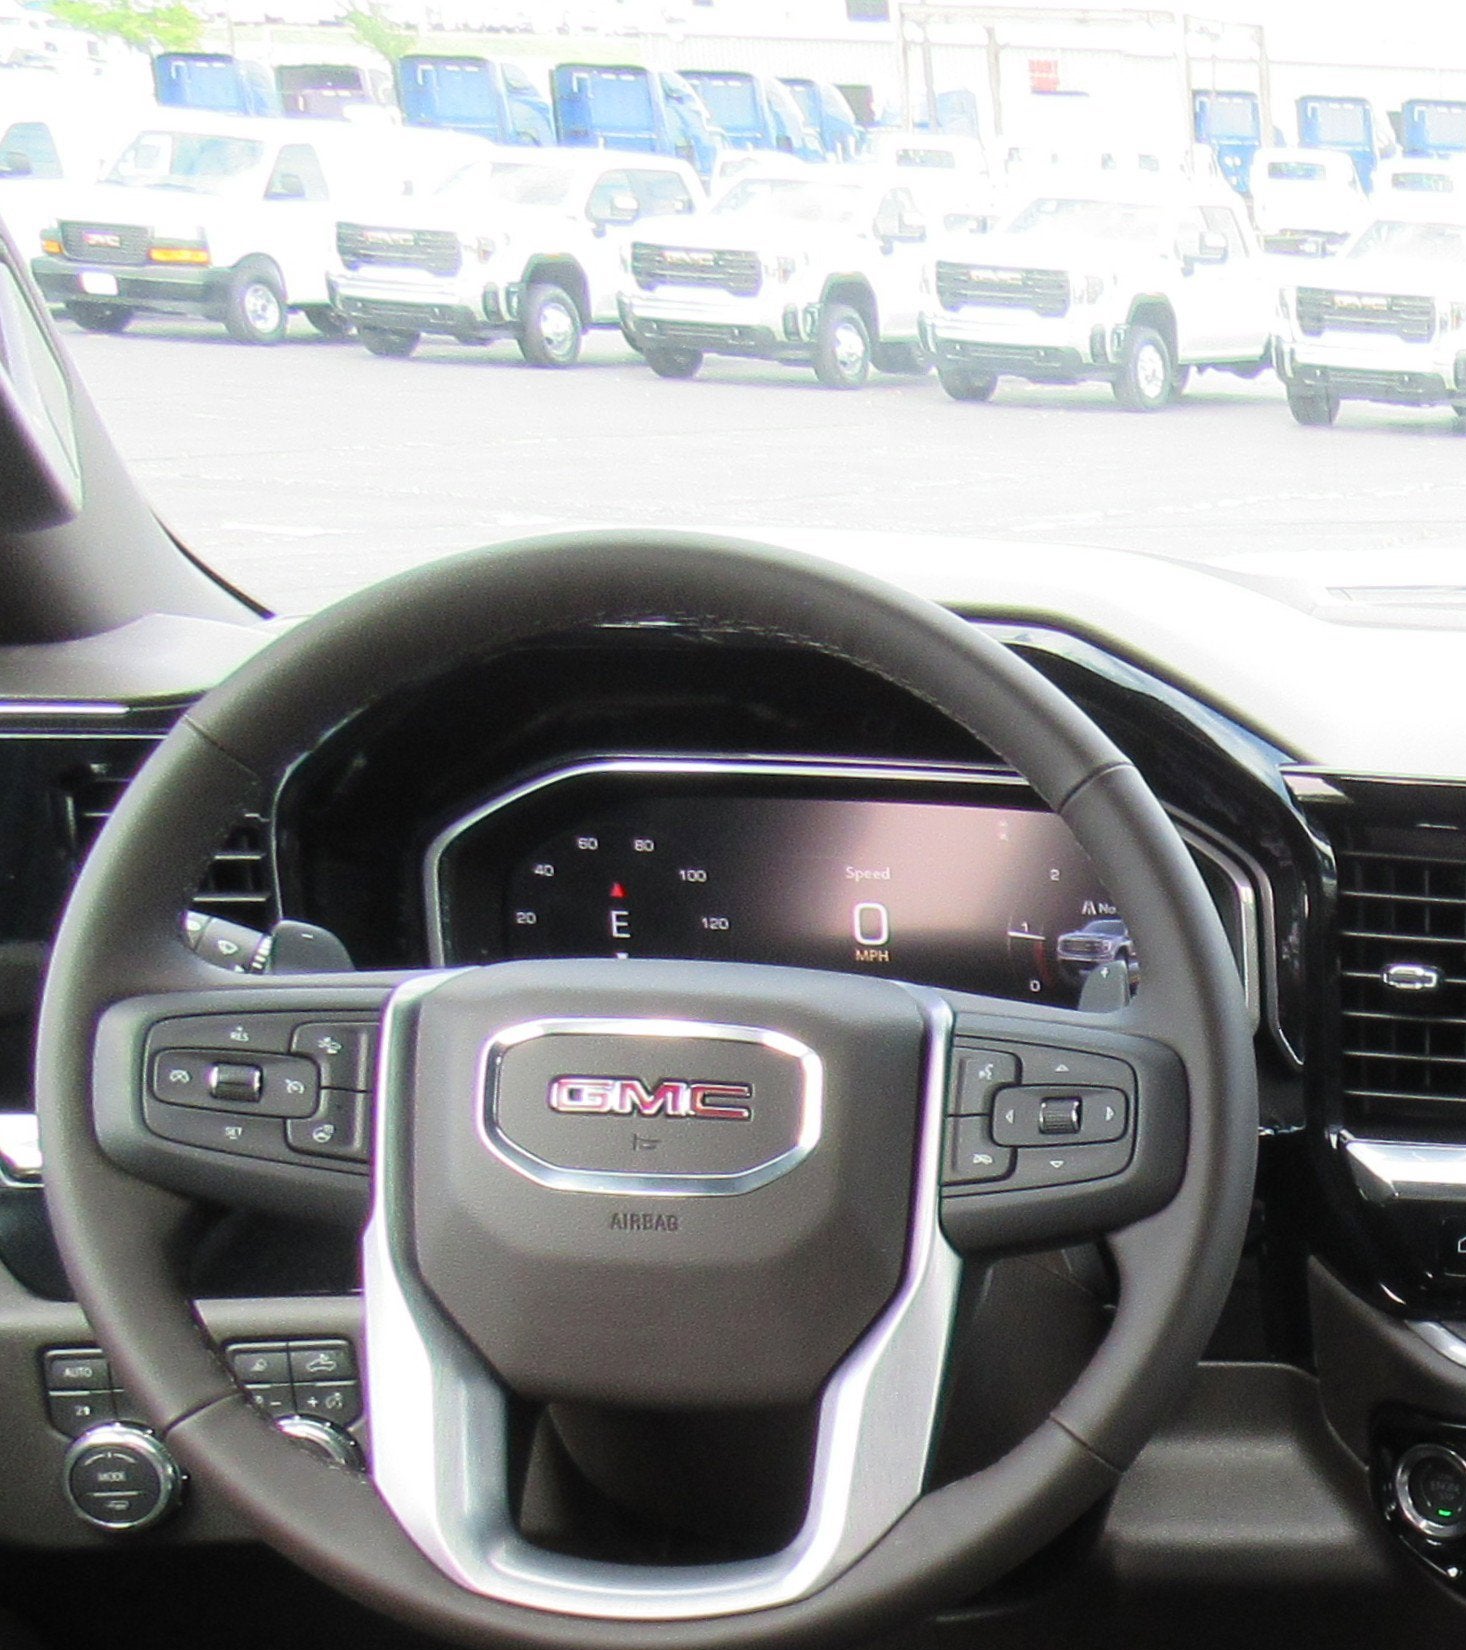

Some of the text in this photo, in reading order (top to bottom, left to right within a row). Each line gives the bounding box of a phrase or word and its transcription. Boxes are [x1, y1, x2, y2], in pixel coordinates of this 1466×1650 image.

[577, 838, 599, 850] 60
[634, 839, 655, 852] 80
[533, 864, 555, 877] 40
[679, 869, 708, 883] 100
[845, 866, 891, 882] Speed
[1050, 869, 1060, 881] 2
[516, 911, 537, 925] 20
[610, 910, 631, 939] E
[702, 917, 730, 930] 120
[853, 902, 889, 946] 0
[855, 949, 890, 962] MPH
[1029, 980, 1040, 991] 0
[549, 1075, 753, 1120] GMC
[610, 1212, 679, 1232] AIRBAG
